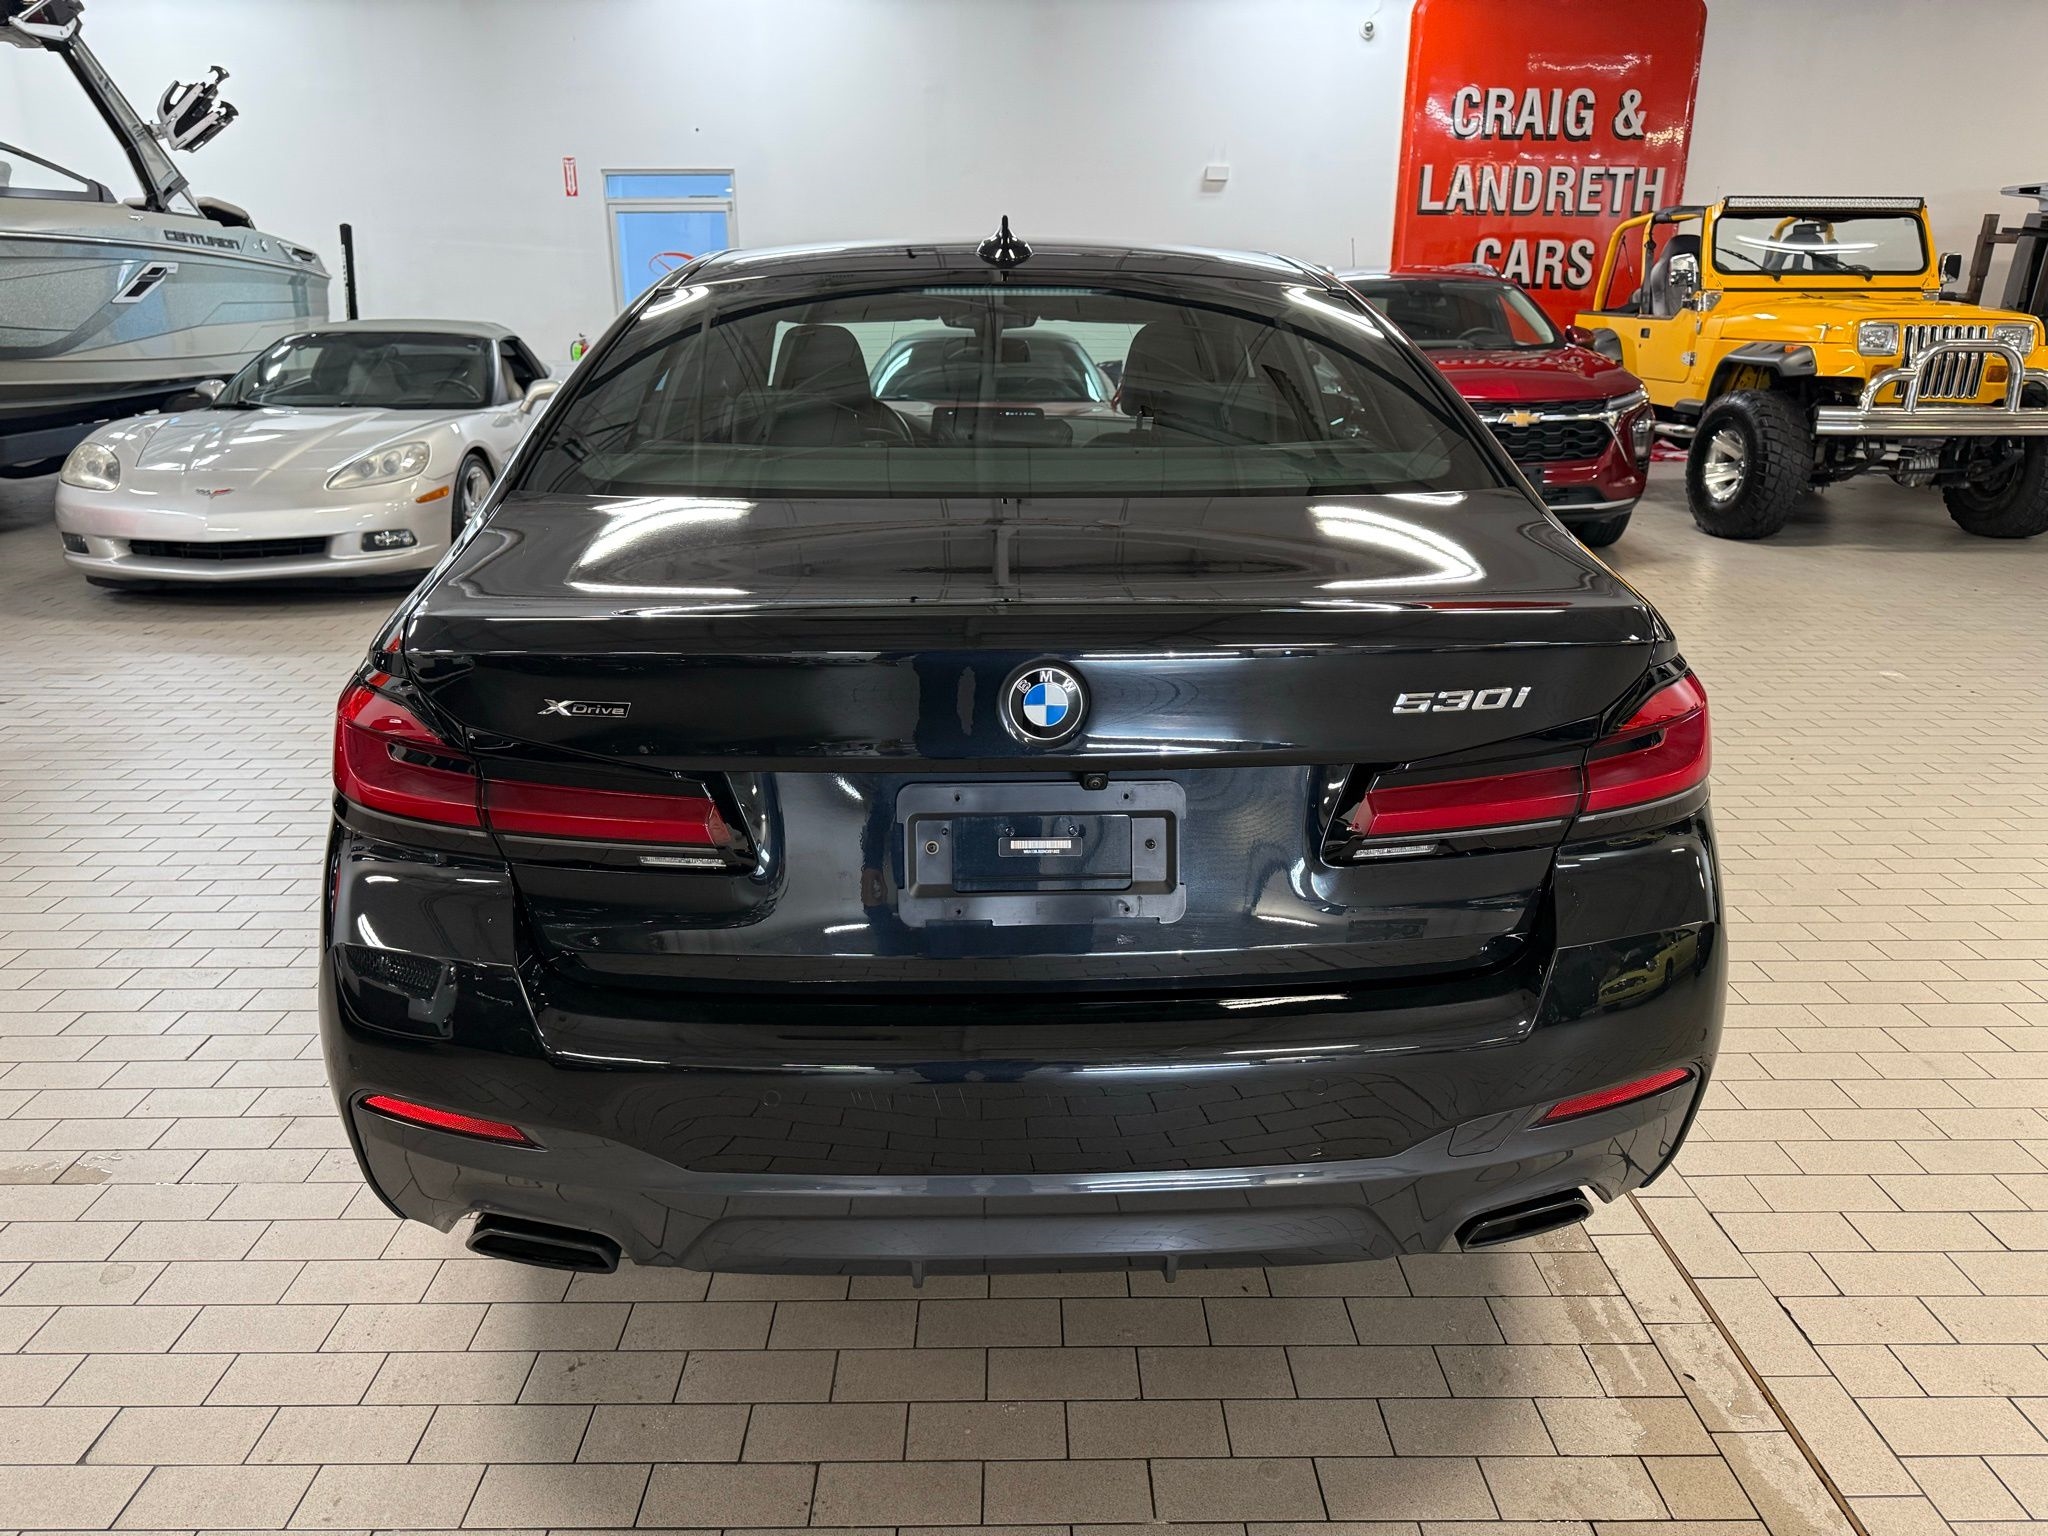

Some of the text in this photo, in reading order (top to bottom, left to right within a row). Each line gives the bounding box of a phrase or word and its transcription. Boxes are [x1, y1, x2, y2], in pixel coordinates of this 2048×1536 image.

[1453, 86, 1648, 140] CRAIG &
[1418, 163, 1667, 215] LANDRETH
[163, 229, 241, 250] CENTURION
[1473, 237, 1595, 289] CARS
[1016, 670, 1077, 694] BMW
[1392, 686, 1532, 714] 530i
